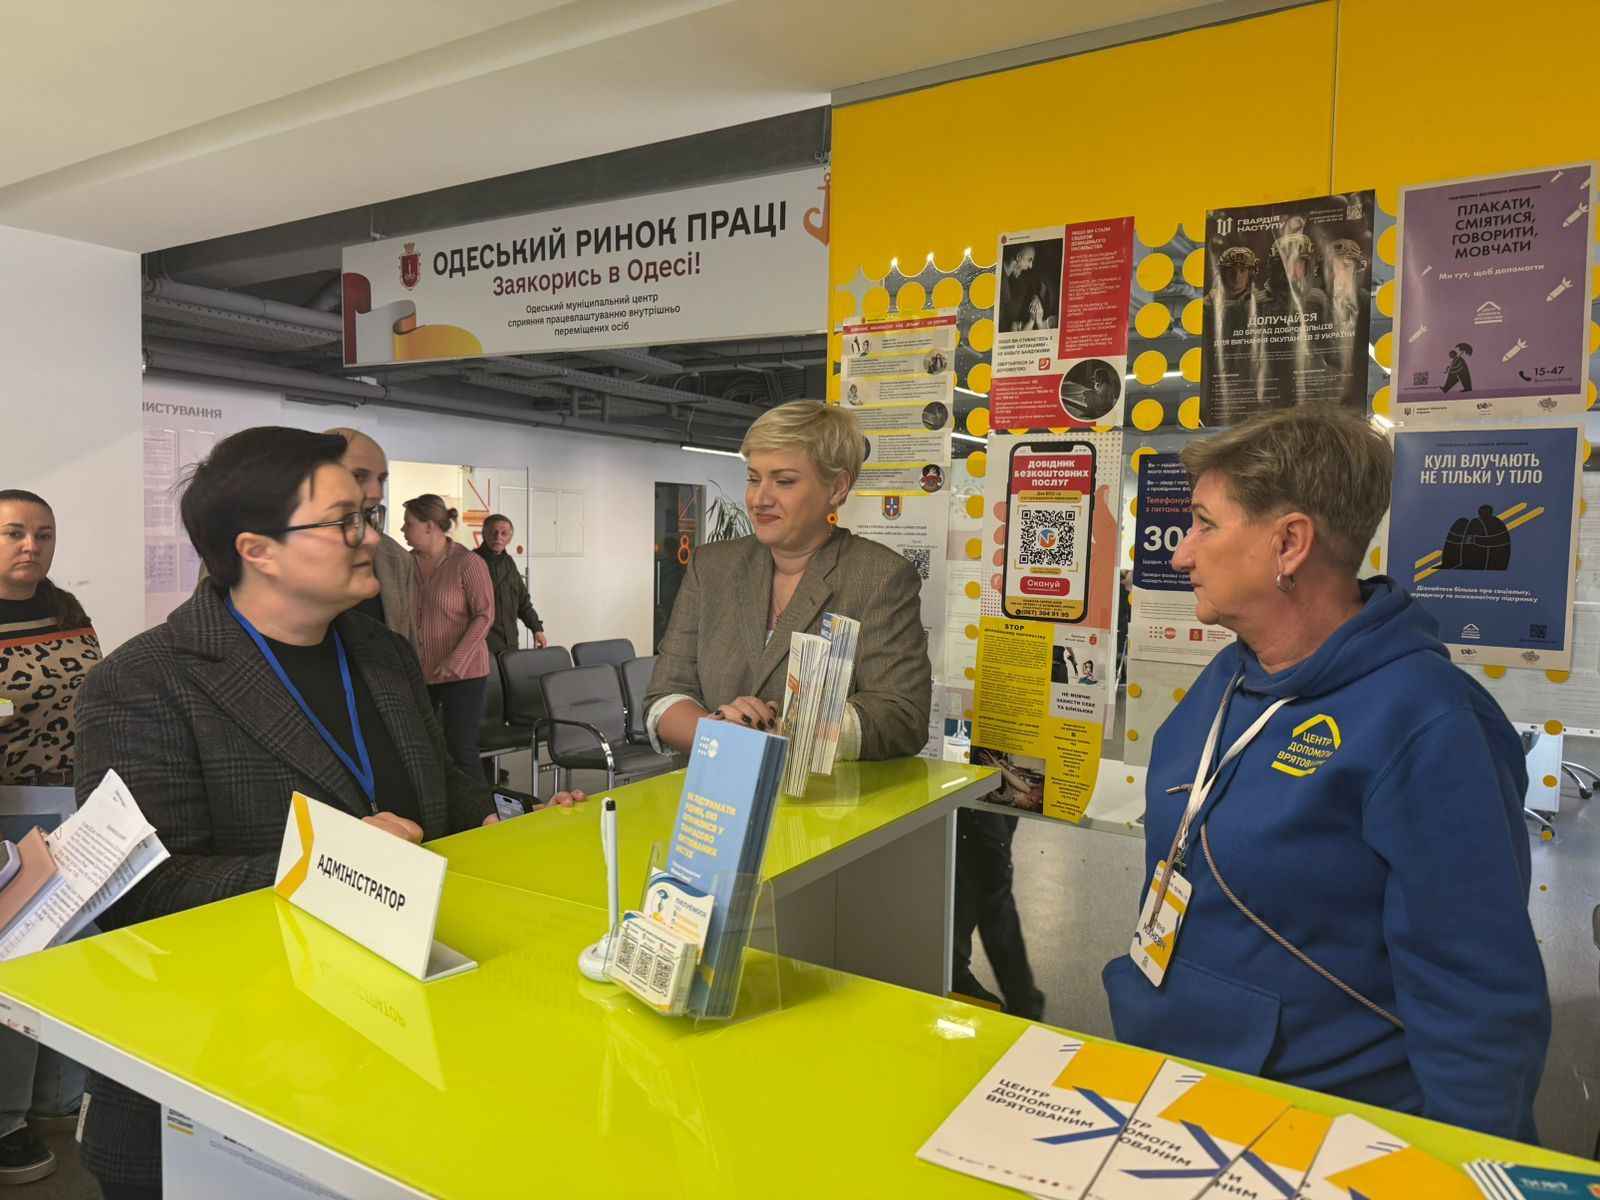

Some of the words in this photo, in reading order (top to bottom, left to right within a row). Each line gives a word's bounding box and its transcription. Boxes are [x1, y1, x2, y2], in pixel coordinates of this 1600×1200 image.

[1457, 197, 1535, 216] ПЛАКАТИ,
[1237, 215, 1280, 225] ГВАРДІЯ
[1455, 211, 1536, 230] СМІЯТИСЯ,
[433, 227, 566, 279] ОДЕСЬКИЙ
[576, 216, 677, 257] РИНОК
[687, 200, 787, 243] ПРАЦІ
[1452, 226, 1538, 245] ГОВОРИТИ,
[1455, 240, 1531, 259] МОВЧАТИ
[493, 268, 602, 296] Заякорись
[609, 266, 620, 283] в
[627, 251, 701, 283] Одесі!
[1473, 268, 1494, 277] щоб
[526, 301, 564, 315] Одеський
[565, 295, 630, 311] муніципальний
[631, 293, 658, 305] центр
[507, 317, 545, 329] сприяння
[546, 308, 627, 327] працевлаштуванню
[629, 305, 681, 319] внутрішньо
[554, 324, 610, 337] переміщених
[611, 321, 630, 332] осіб
[1534, 366, 1565, 377] 15-47
[142, 401, 223, 419] ИСТУВАННЯ
[1028, 460, 1076, 469] ДОВІДНИК
[1424, 454, 1458, 469] КУЛІ
[1460, 453, 1541, 469] ВЛУЧАЮТЬ
[1420, 470, 1437, 484] НЕ
[1441, 470, 1492, 484] ТІЛЬКИ
[1496, 471, 1505, 485] У
[1509, 470, 1543, 484] ТІЛО
[1143, 525, 1192, 552] 30
[1027, 579, 1060, 588] Скануй
[1004, 623, 1025, 631] STOP
[1302, 732, 1333, 747] ЦЕНТР
[317, 854, 406, 912] АДМІНІСТРАТОР
[999, 1078, 1051, 1099] ЦЕНТР
[985, 1094, 1096, 1129] ВРЯТОВАНИМ
[991, 1087, 1083, 1117] ДОПОМОГИ
[1124, 1127, 1182, 1152] ОМОГИ
[1119, 1136, 1192, 1167] ОВАНИМ
